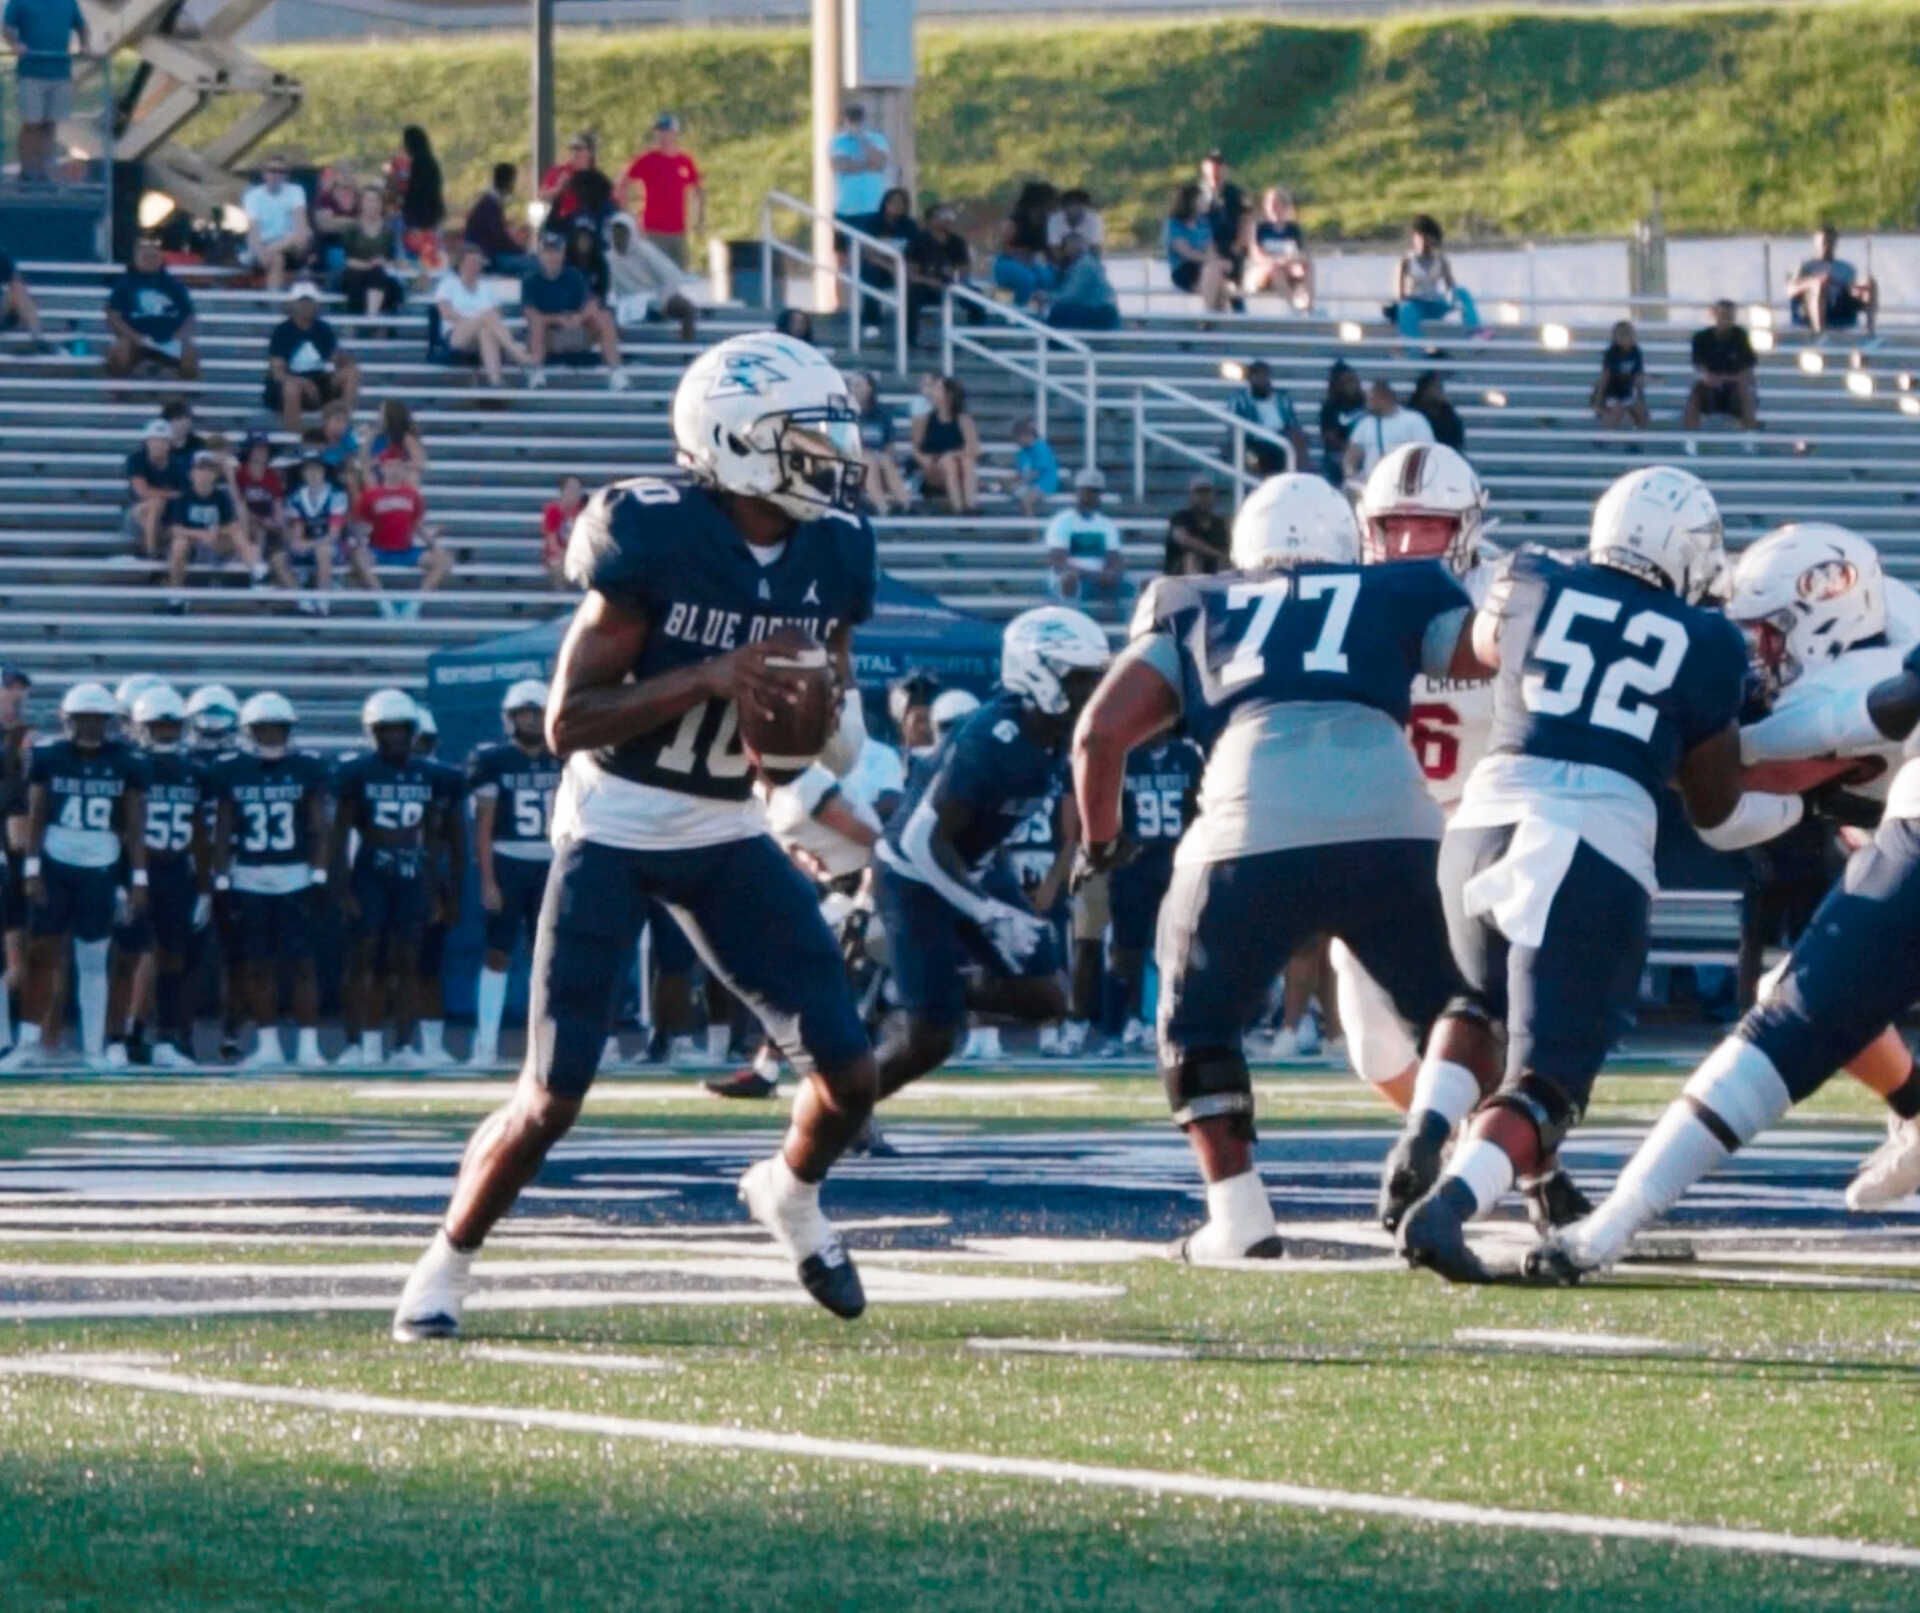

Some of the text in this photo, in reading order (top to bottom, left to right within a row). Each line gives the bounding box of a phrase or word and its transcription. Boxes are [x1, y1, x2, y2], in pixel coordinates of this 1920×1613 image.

[664, 603, 741, 649] BLUE
[1221, 573, 1361, 687] 77
[1522, 587, 1690, 743] 52
[1410, 703, 1460, 780] 6
[144, 801, 194, 850] 55
[243, 801, 296, 851] 33
[515, 789, 554, 837] 5
[1135, 789, 1183, 837] 95
